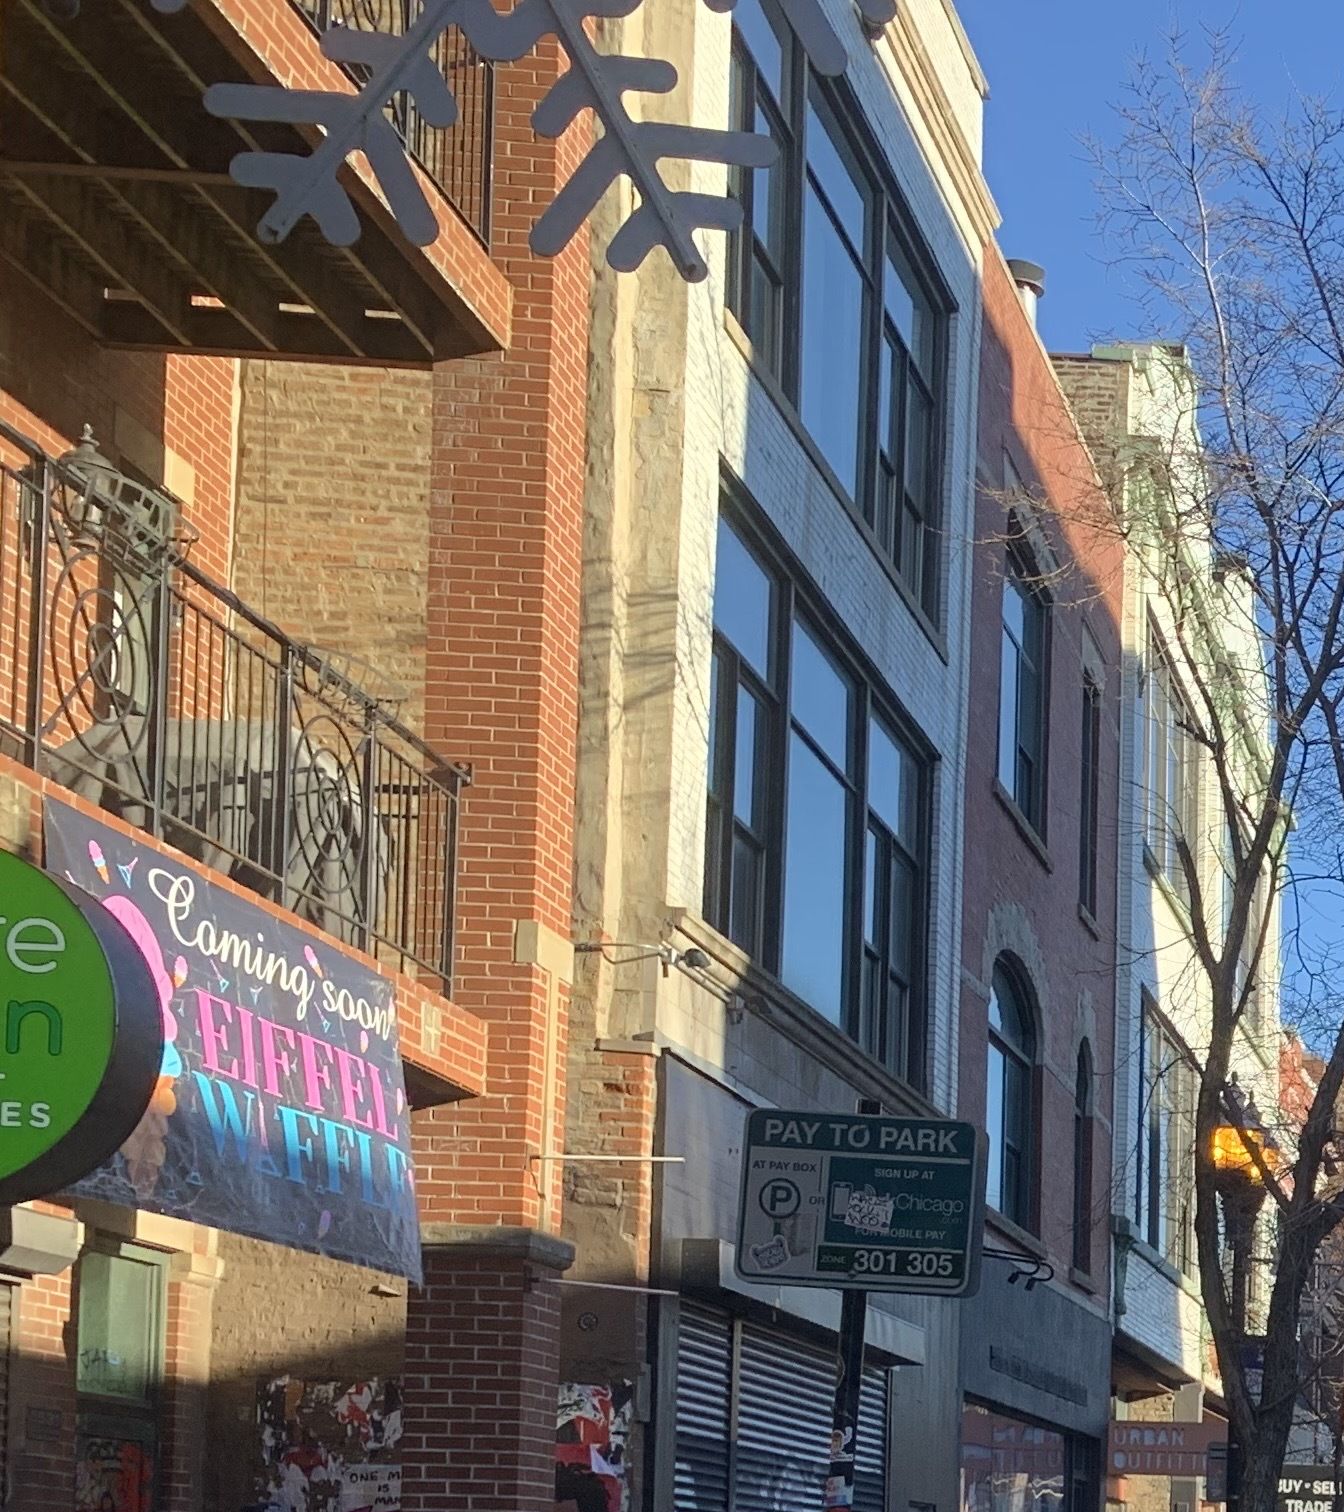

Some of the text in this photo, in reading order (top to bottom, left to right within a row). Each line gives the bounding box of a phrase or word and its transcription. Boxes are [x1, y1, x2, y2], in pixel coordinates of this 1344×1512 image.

[0, 916, 66, 974] e
[148, 868, 393, 1041] Coming soon
[194, 987, 400, 1142] EIFFEL
[763, 1118, 960, 1153] PAY TO PARK
[752, 1161, 817, 1173] AT PAY BOX
[874, 1167, 935, 1180] SIGN UP AT
[808, 1195, 825, 1206] OR
[925, 1230, 946, 1240] PAY
[820, 1249, 953, 1276] ZONE 301 305
[1114, 1426, 1185, 1446] URBAN
[349, 1472, 378, 1484] ONE
